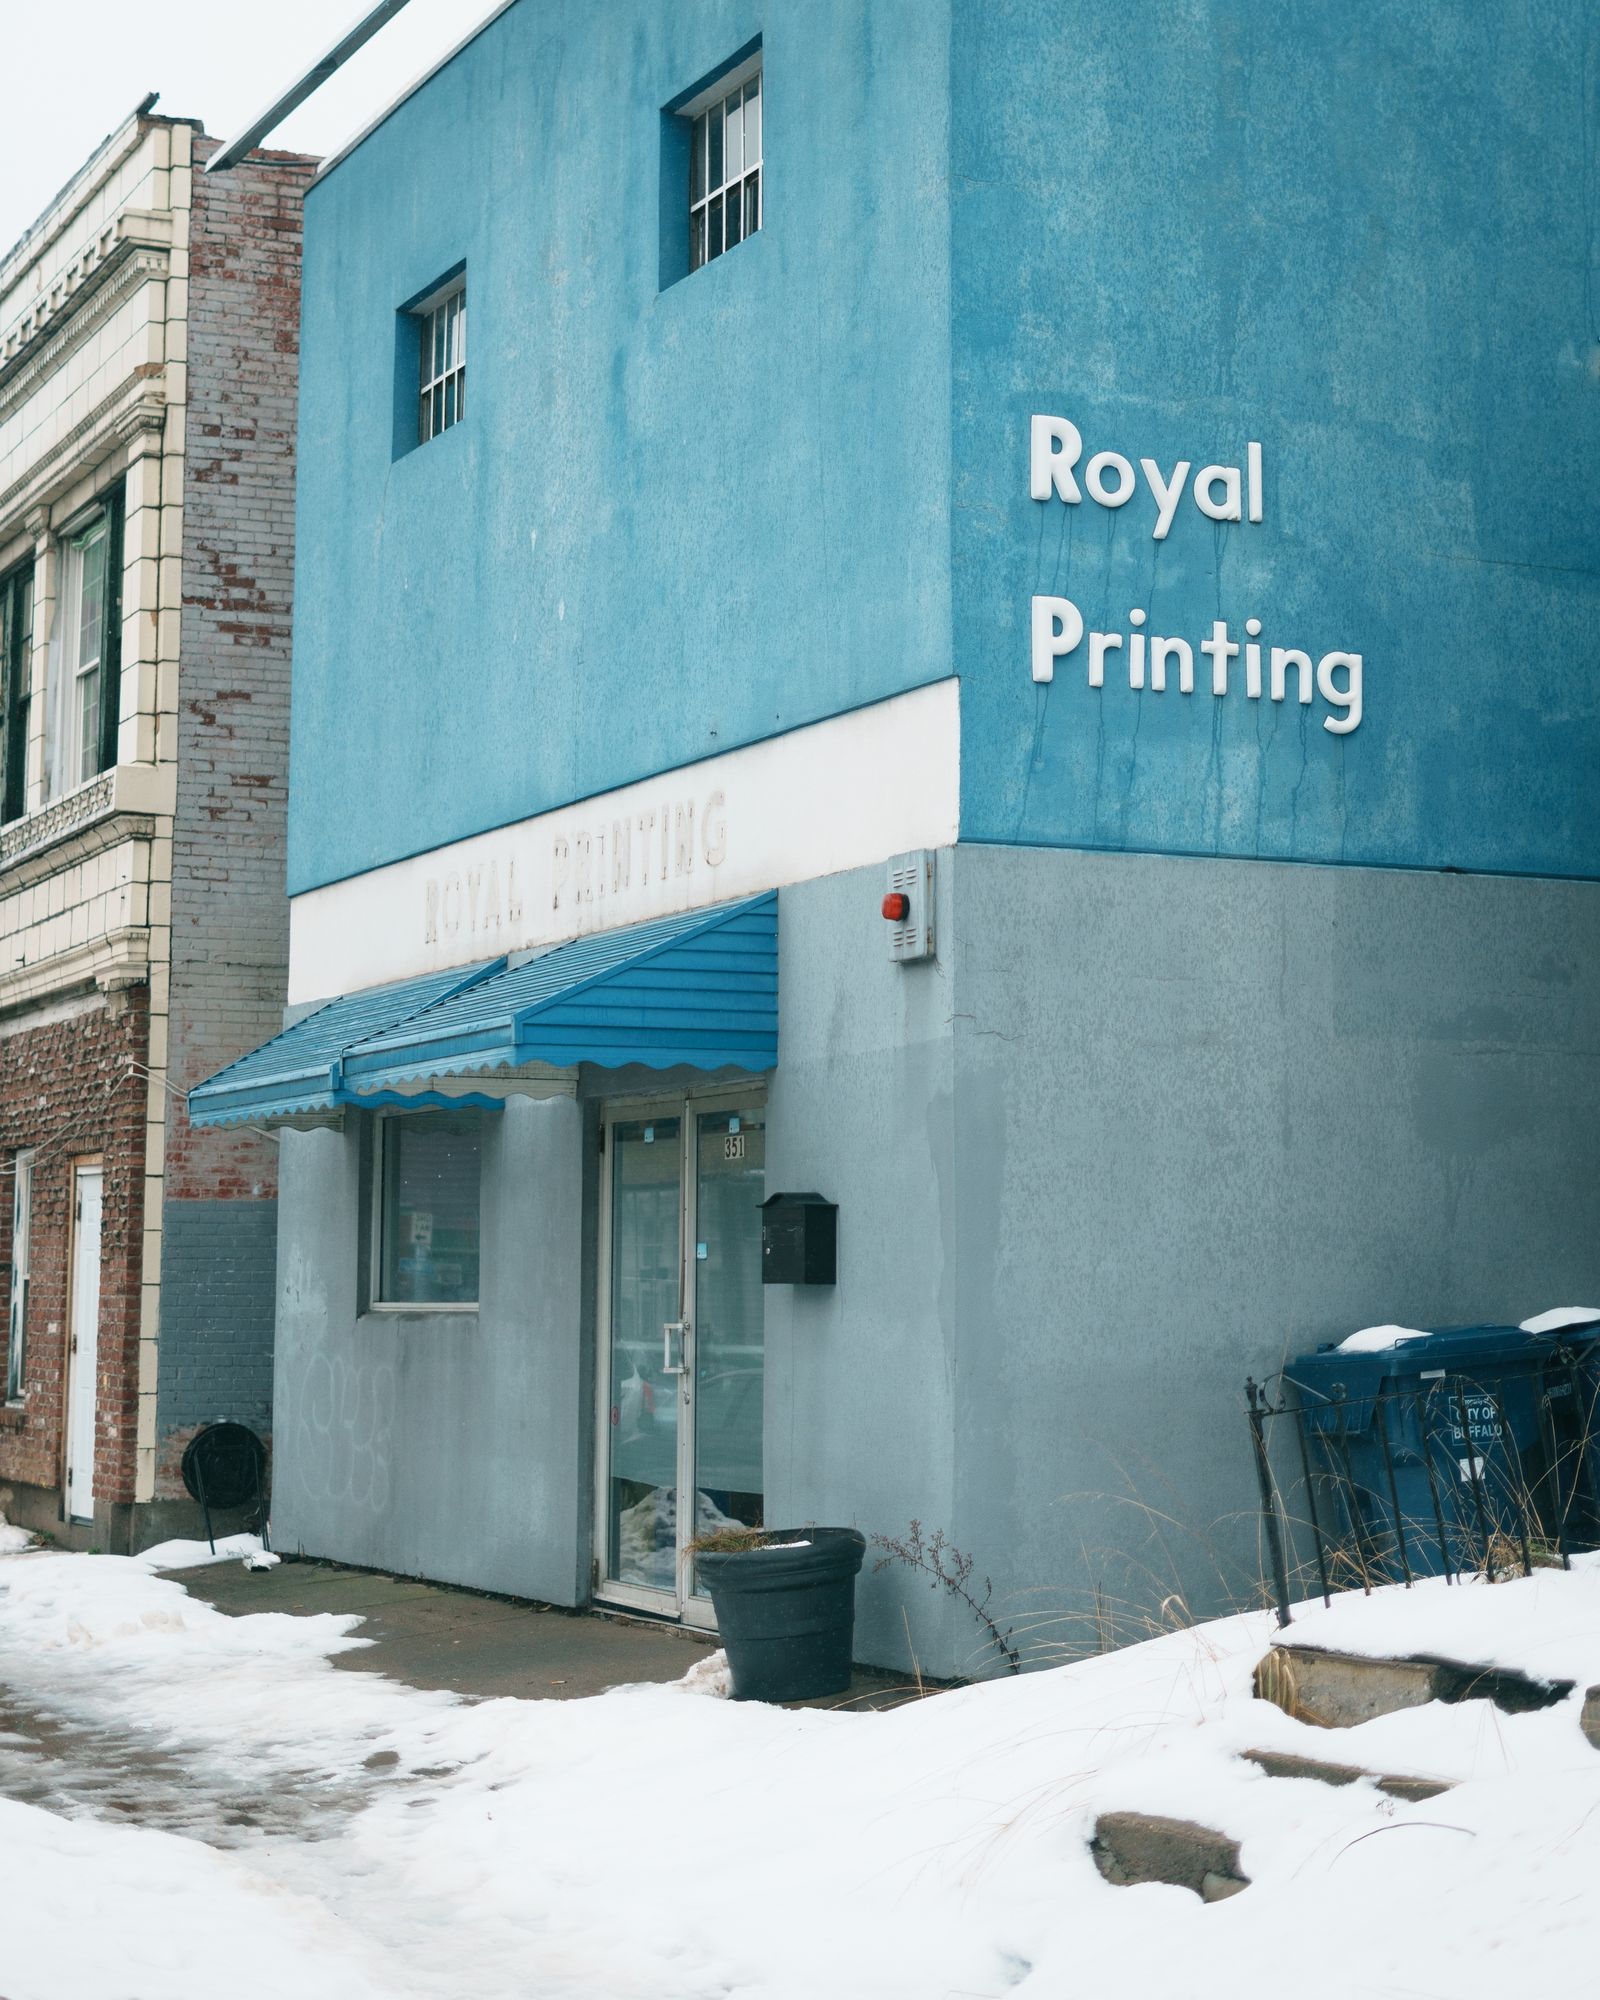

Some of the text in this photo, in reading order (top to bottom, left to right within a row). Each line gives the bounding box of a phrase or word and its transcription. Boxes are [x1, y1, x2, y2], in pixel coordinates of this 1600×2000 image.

[1030, 414, 1263, 540] Royal
[1031, 595, 1363, 735] Printing
[424, 789, 729, 945] ROYAL PRINTING
[724, 1137, 744, 1158] 351
[1482, 1406, 1497, 1420] OF
